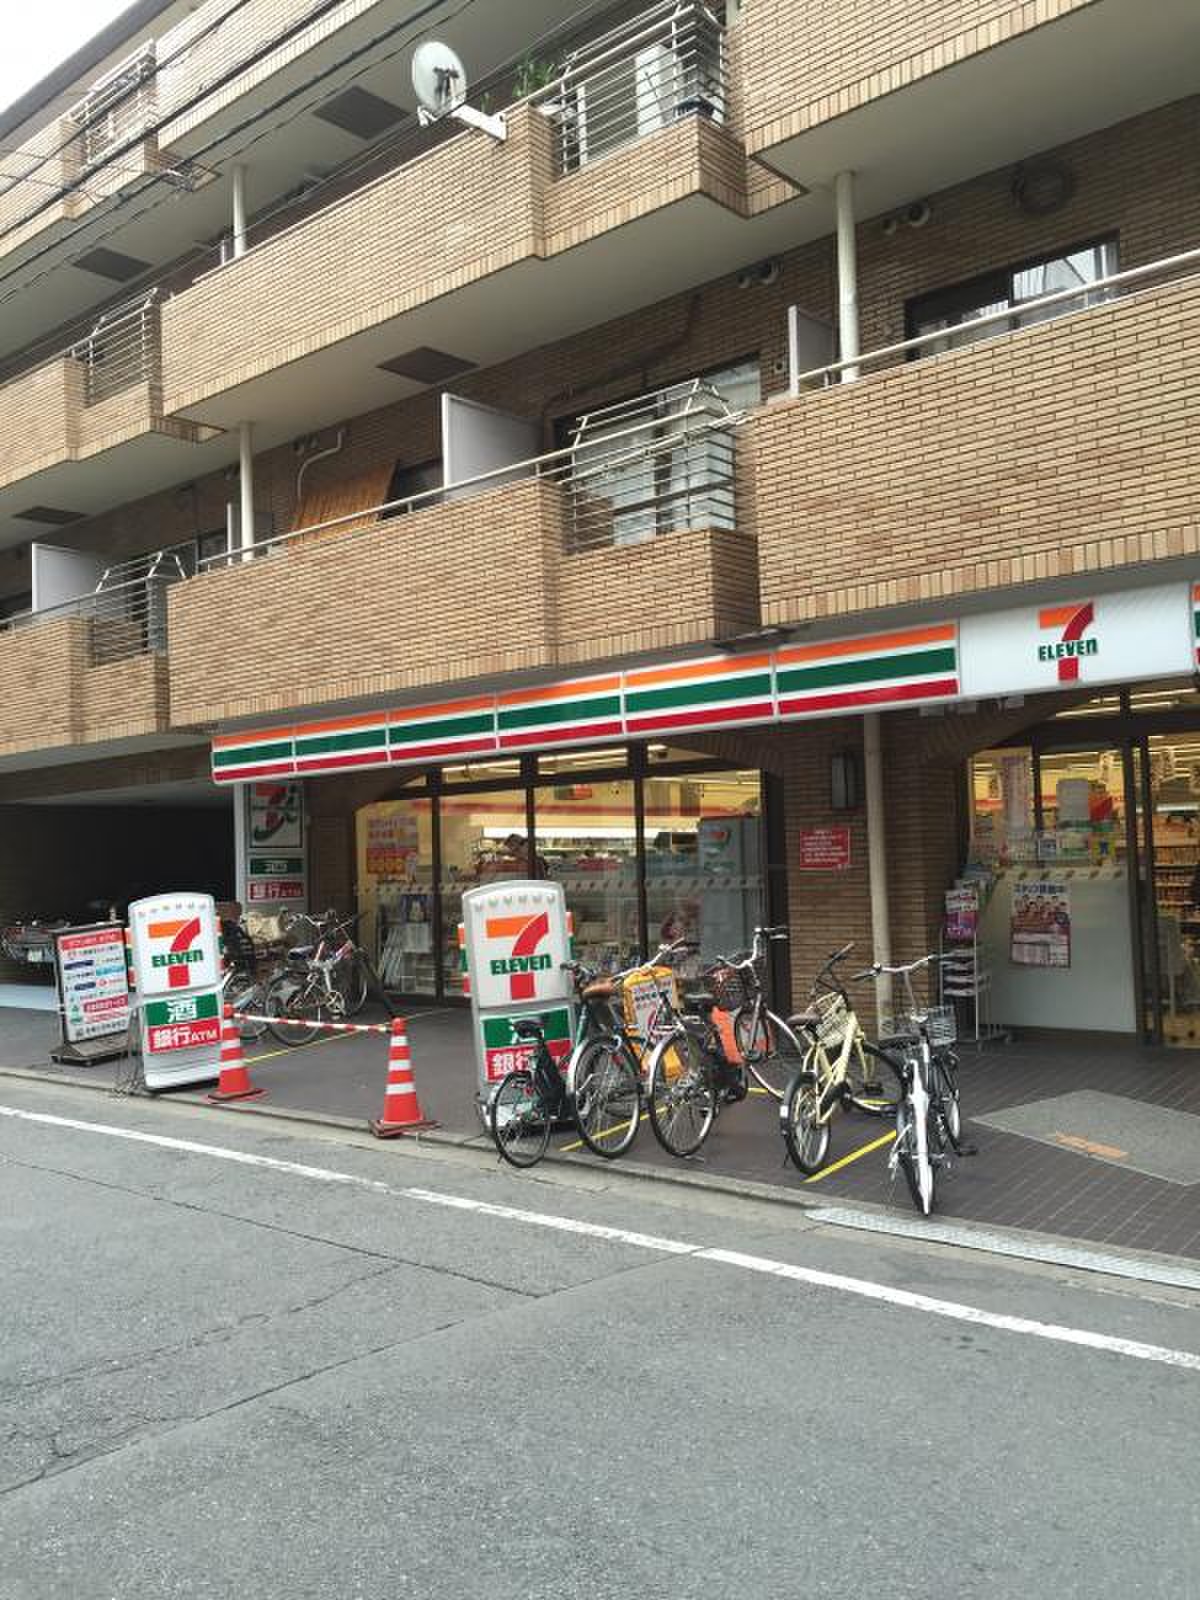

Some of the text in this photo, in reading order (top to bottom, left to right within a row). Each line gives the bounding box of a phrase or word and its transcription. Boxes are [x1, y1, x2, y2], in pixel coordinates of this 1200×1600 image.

[1038, 601, 1094, 681] 7
[148, 916, 201, 988] 7
[486, 911, 550, 1001] 7
[153, 1025, 219, 1052] 銀行ATM
[166, 998, 198, 1024] 酒
